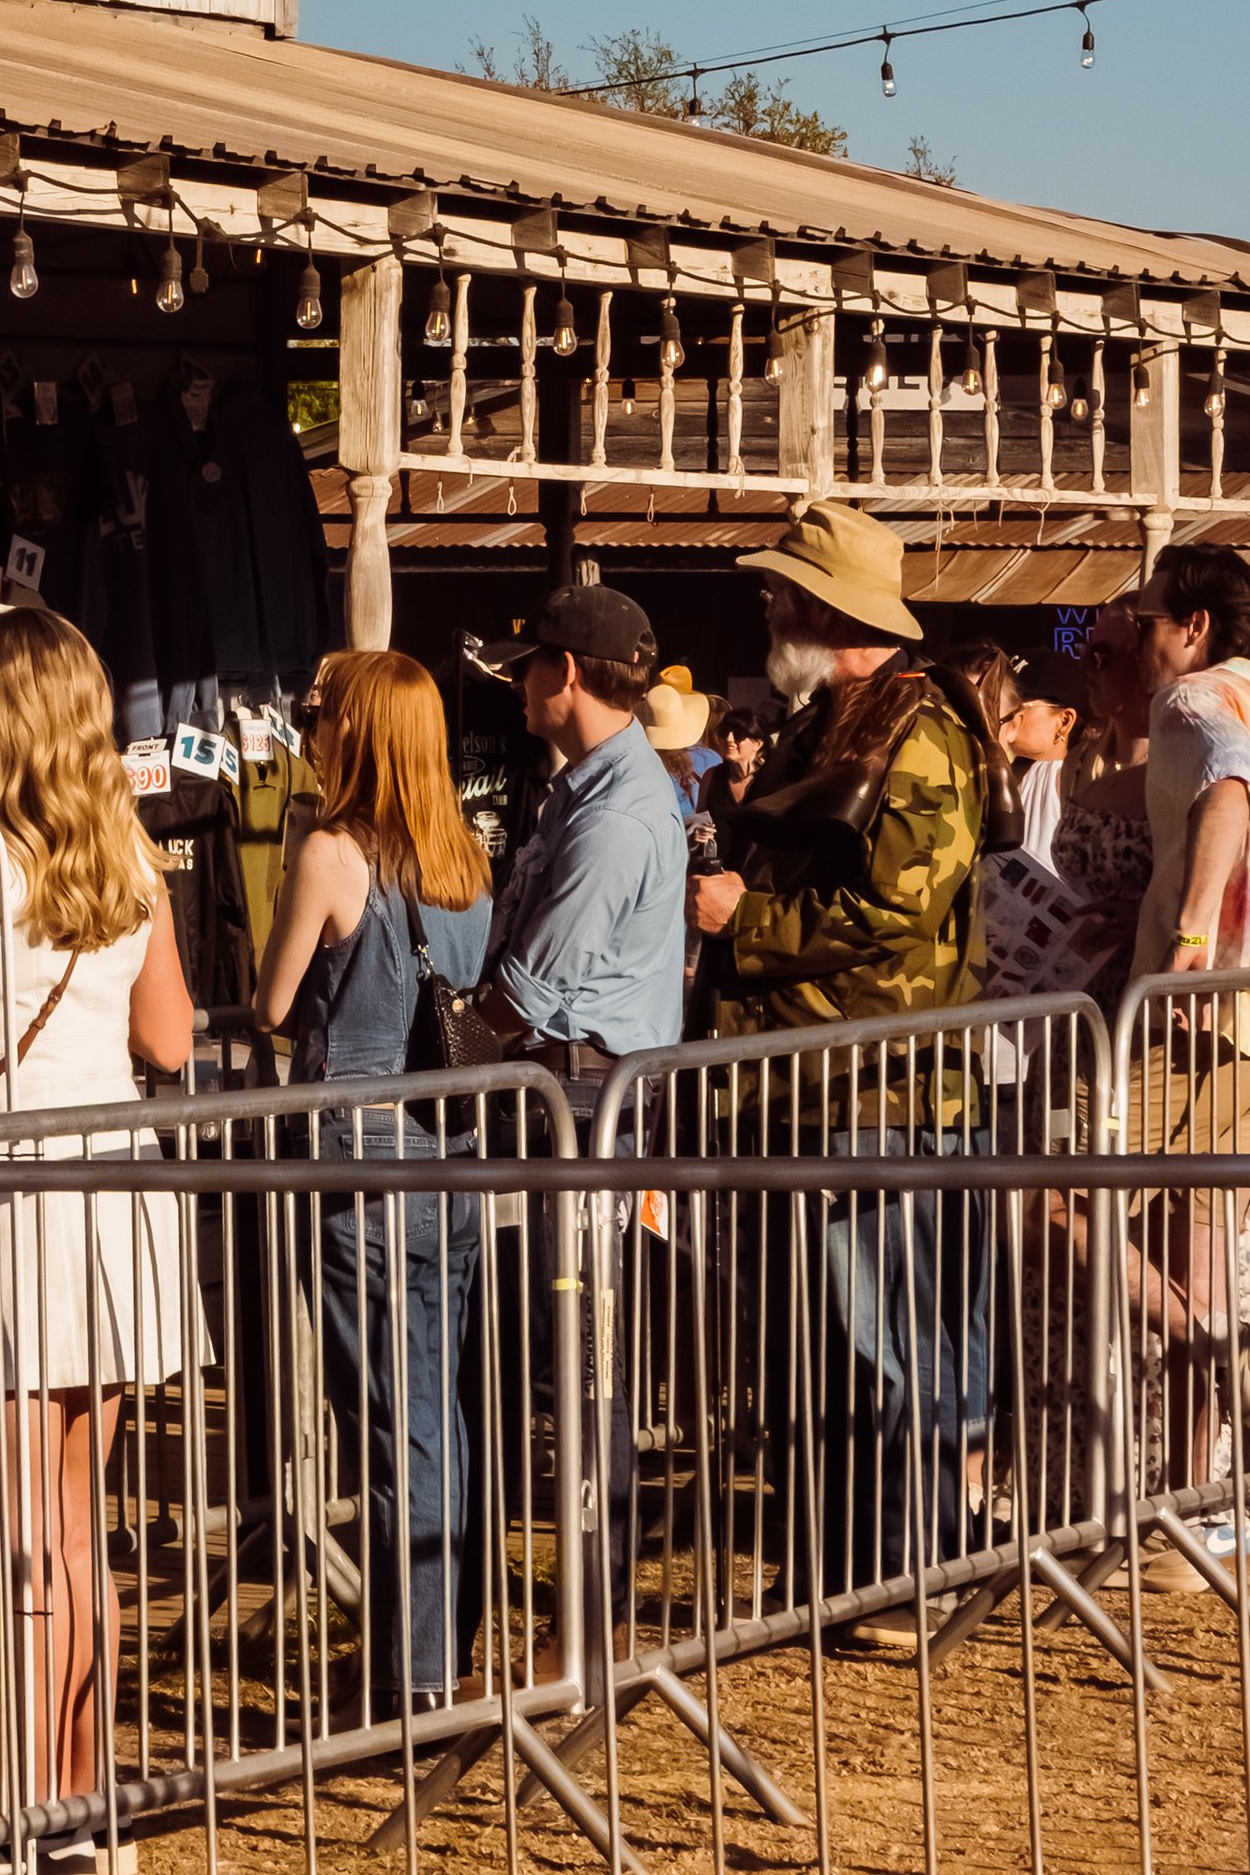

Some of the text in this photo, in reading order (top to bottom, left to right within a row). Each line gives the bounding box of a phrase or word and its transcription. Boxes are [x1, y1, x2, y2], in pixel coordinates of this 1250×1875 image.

[16, 547, 37, 576] 11
[181, 735, 217, 765] 15
[241, 733, 270, 753] $125
[221, 746, 237, 773] 5
